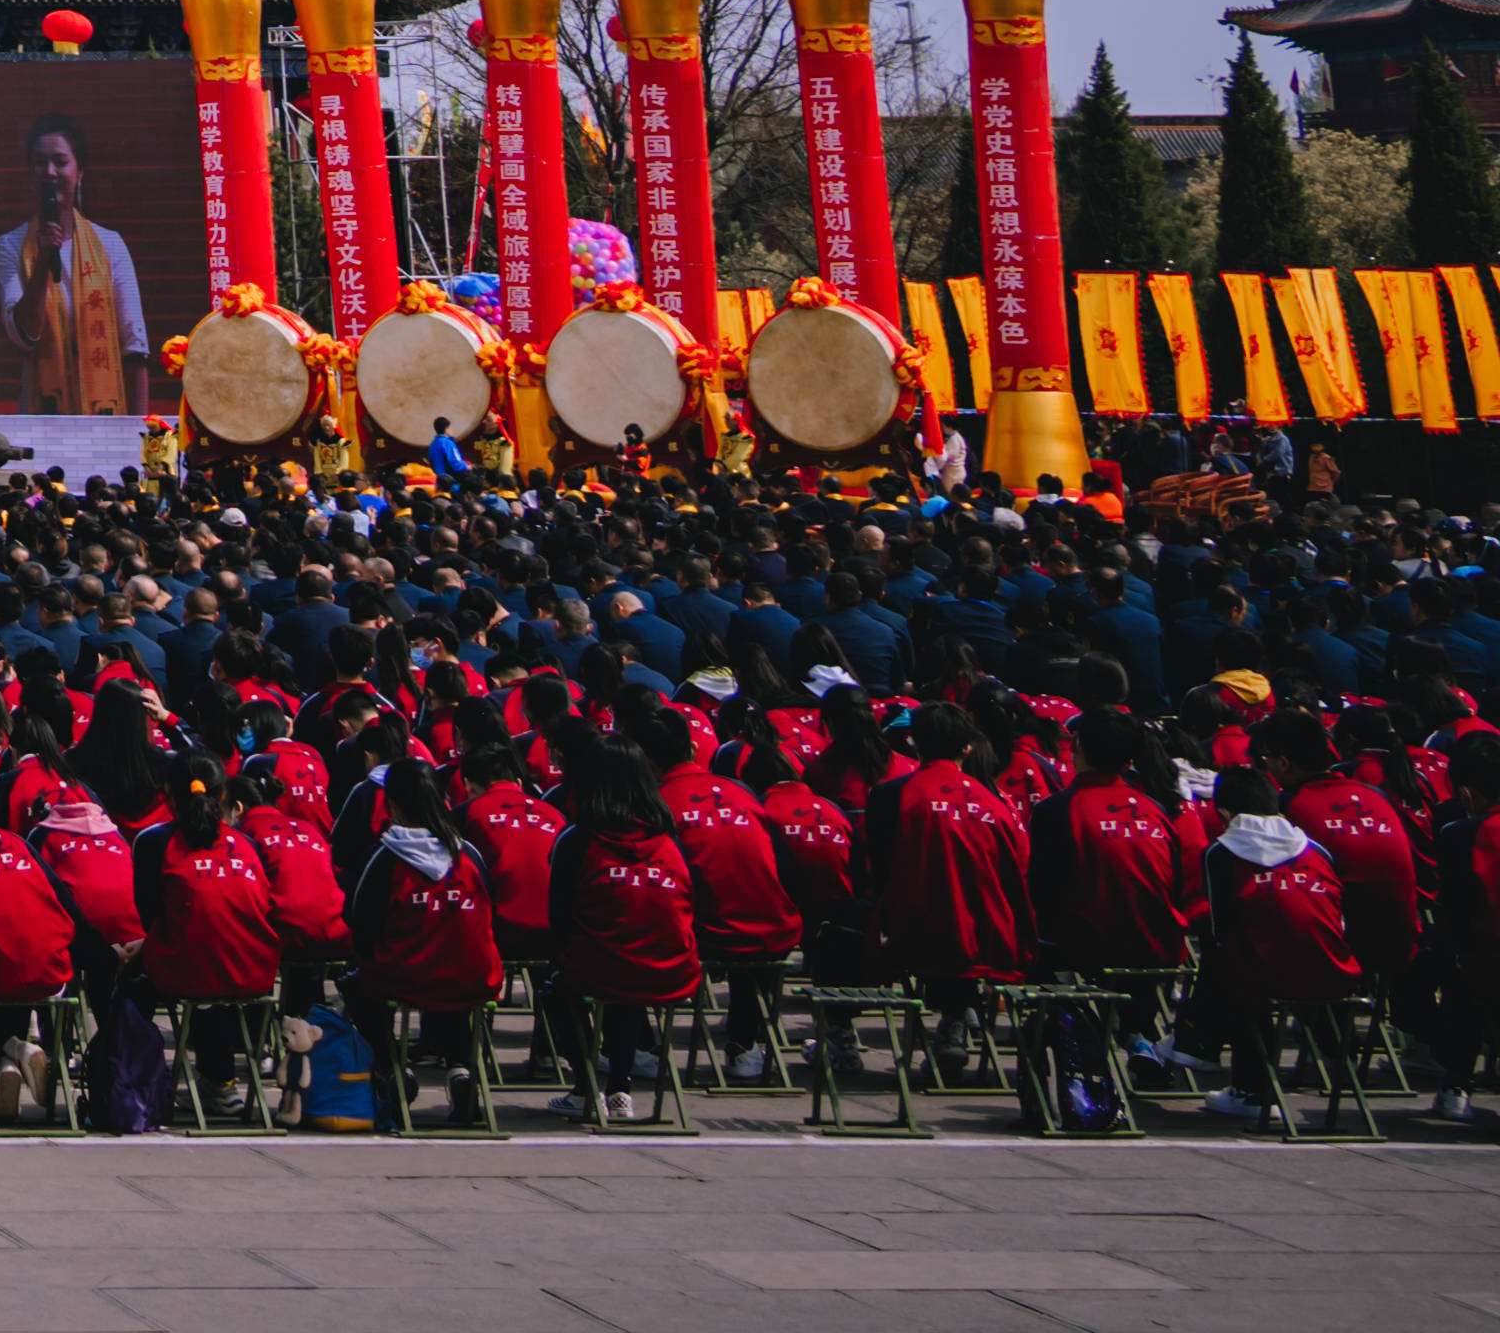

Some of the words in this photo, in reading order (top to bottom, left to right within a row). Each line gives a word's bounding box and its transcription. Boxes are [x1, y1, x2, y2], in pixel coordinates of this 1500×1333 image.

[319, 95, 367, 338] 寻根铸魂坚守文化沃土
[495, 84, 534, 334] 转型擘画全域旅游愿景
[980, 78, 1029, 345] 学党史悟思想永葆本色
